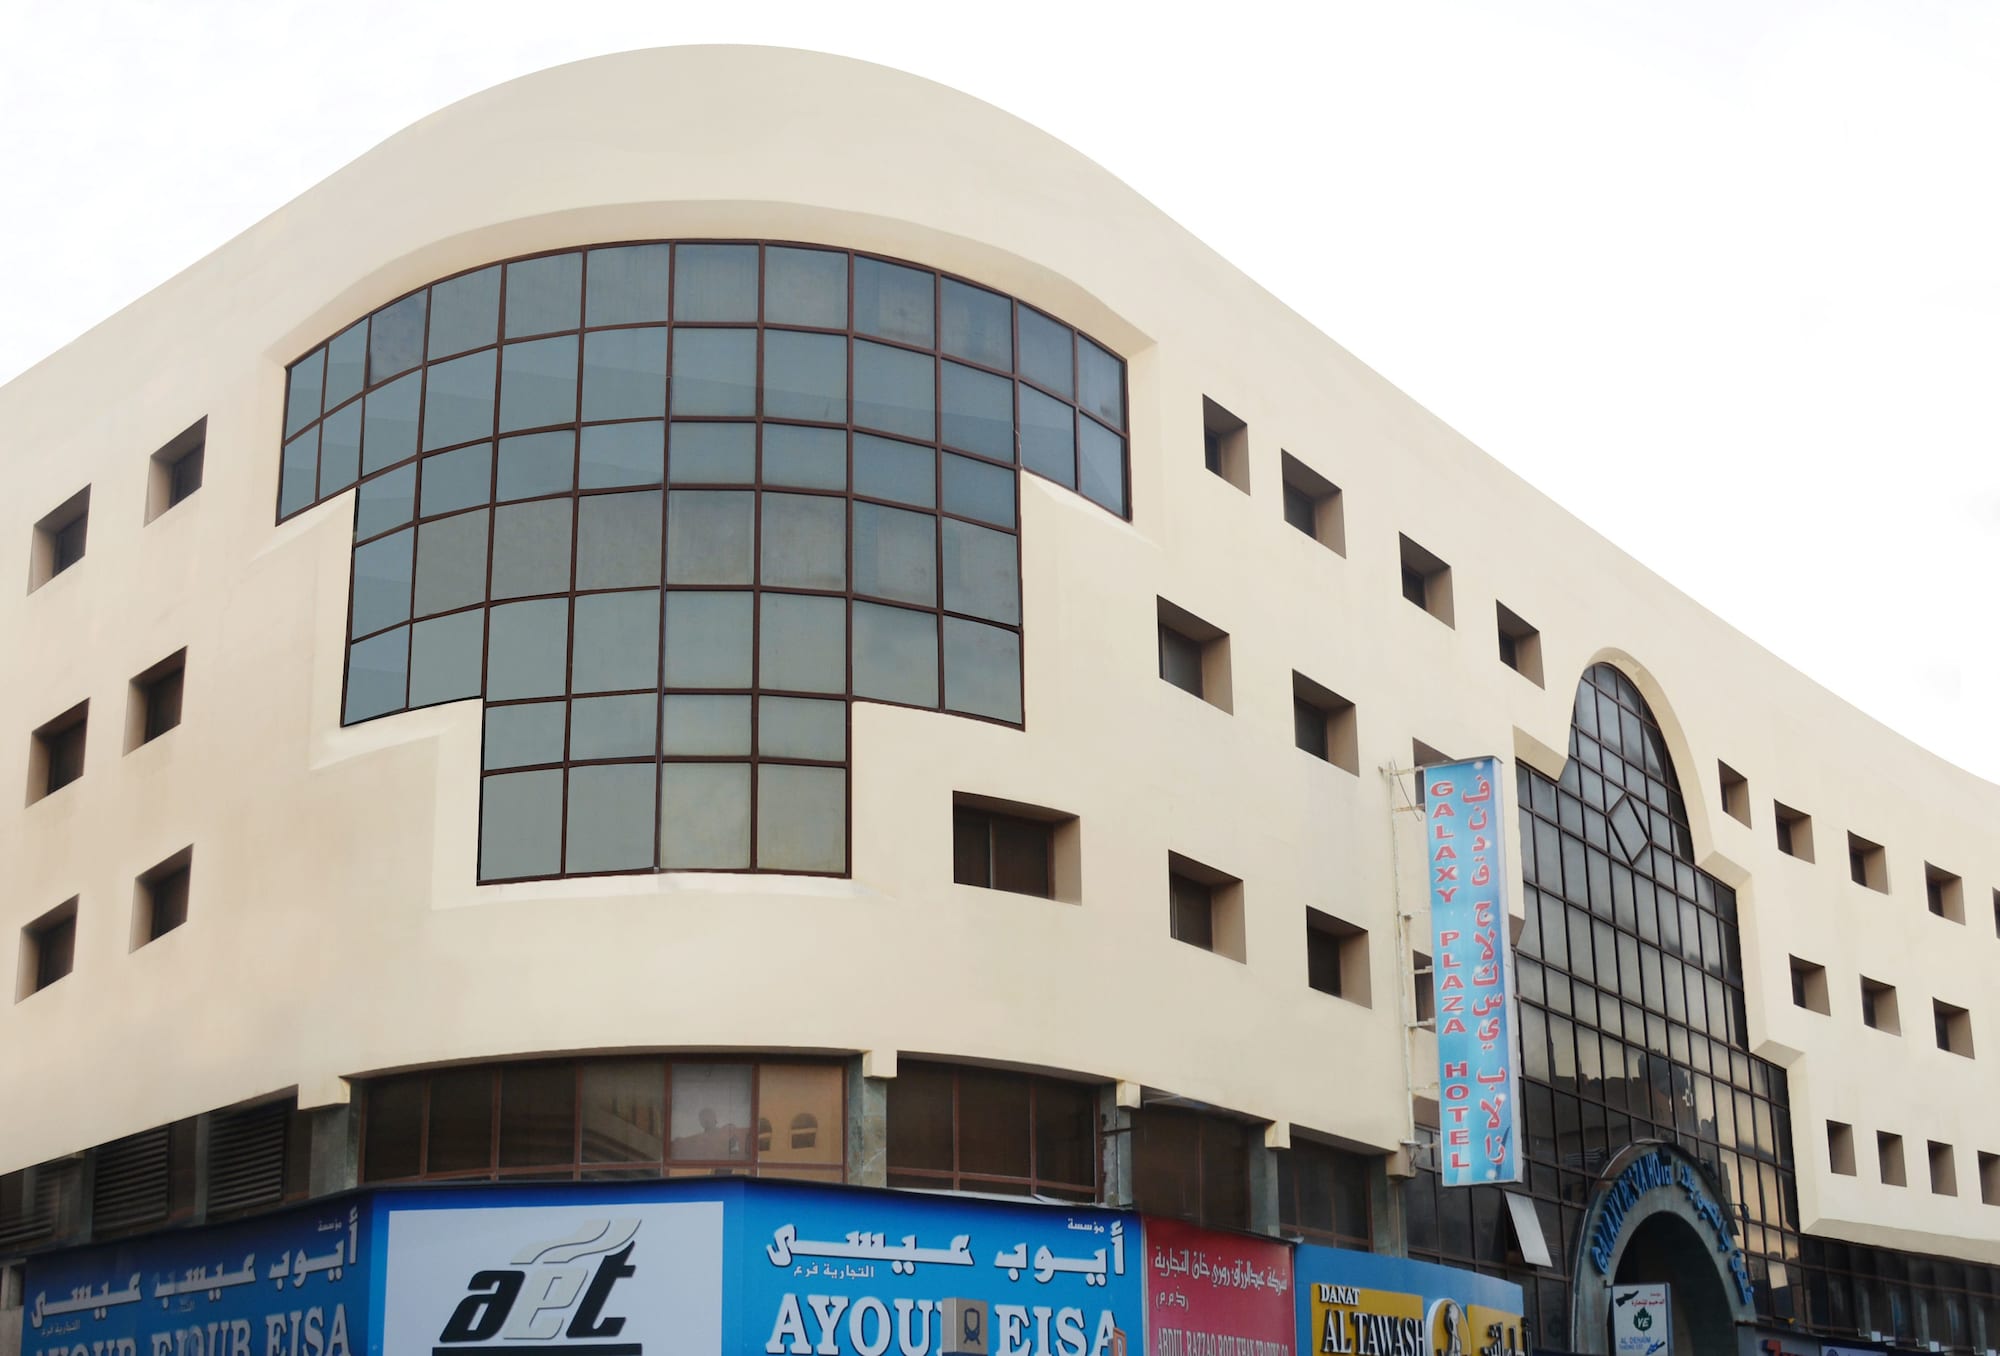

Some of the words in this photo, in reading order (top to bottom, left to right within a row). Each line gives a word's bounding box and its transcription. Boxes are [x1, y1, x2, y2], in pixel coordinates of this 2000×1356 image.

[1430, 781, 1459, 903] GALAXY
[1440, 930, 1467, 1034] PLAZA
[1444, 1061, 1470, 1169] HOTEL
[268, 1205, 359, 1291] أيوب
[765, 1223, 974, 1276] عيسى
[993, 1218, 1125, 1287] أيوب
[1067, 1218, 1105, 1234] مؤسسة
[1591, 1187, 1624, 1275] GALAXY
[823, 1262, 875, 1281] التجارية
[1154, 1245, 1190, 1278] التجارية
[765, 1293, 943, 1356] AYOU
[993, 1304, 1119, 1356] EISA
[1319, 1284, 1361, 1306] DANAT
[1324, 1309, 1353, 1354] AL
